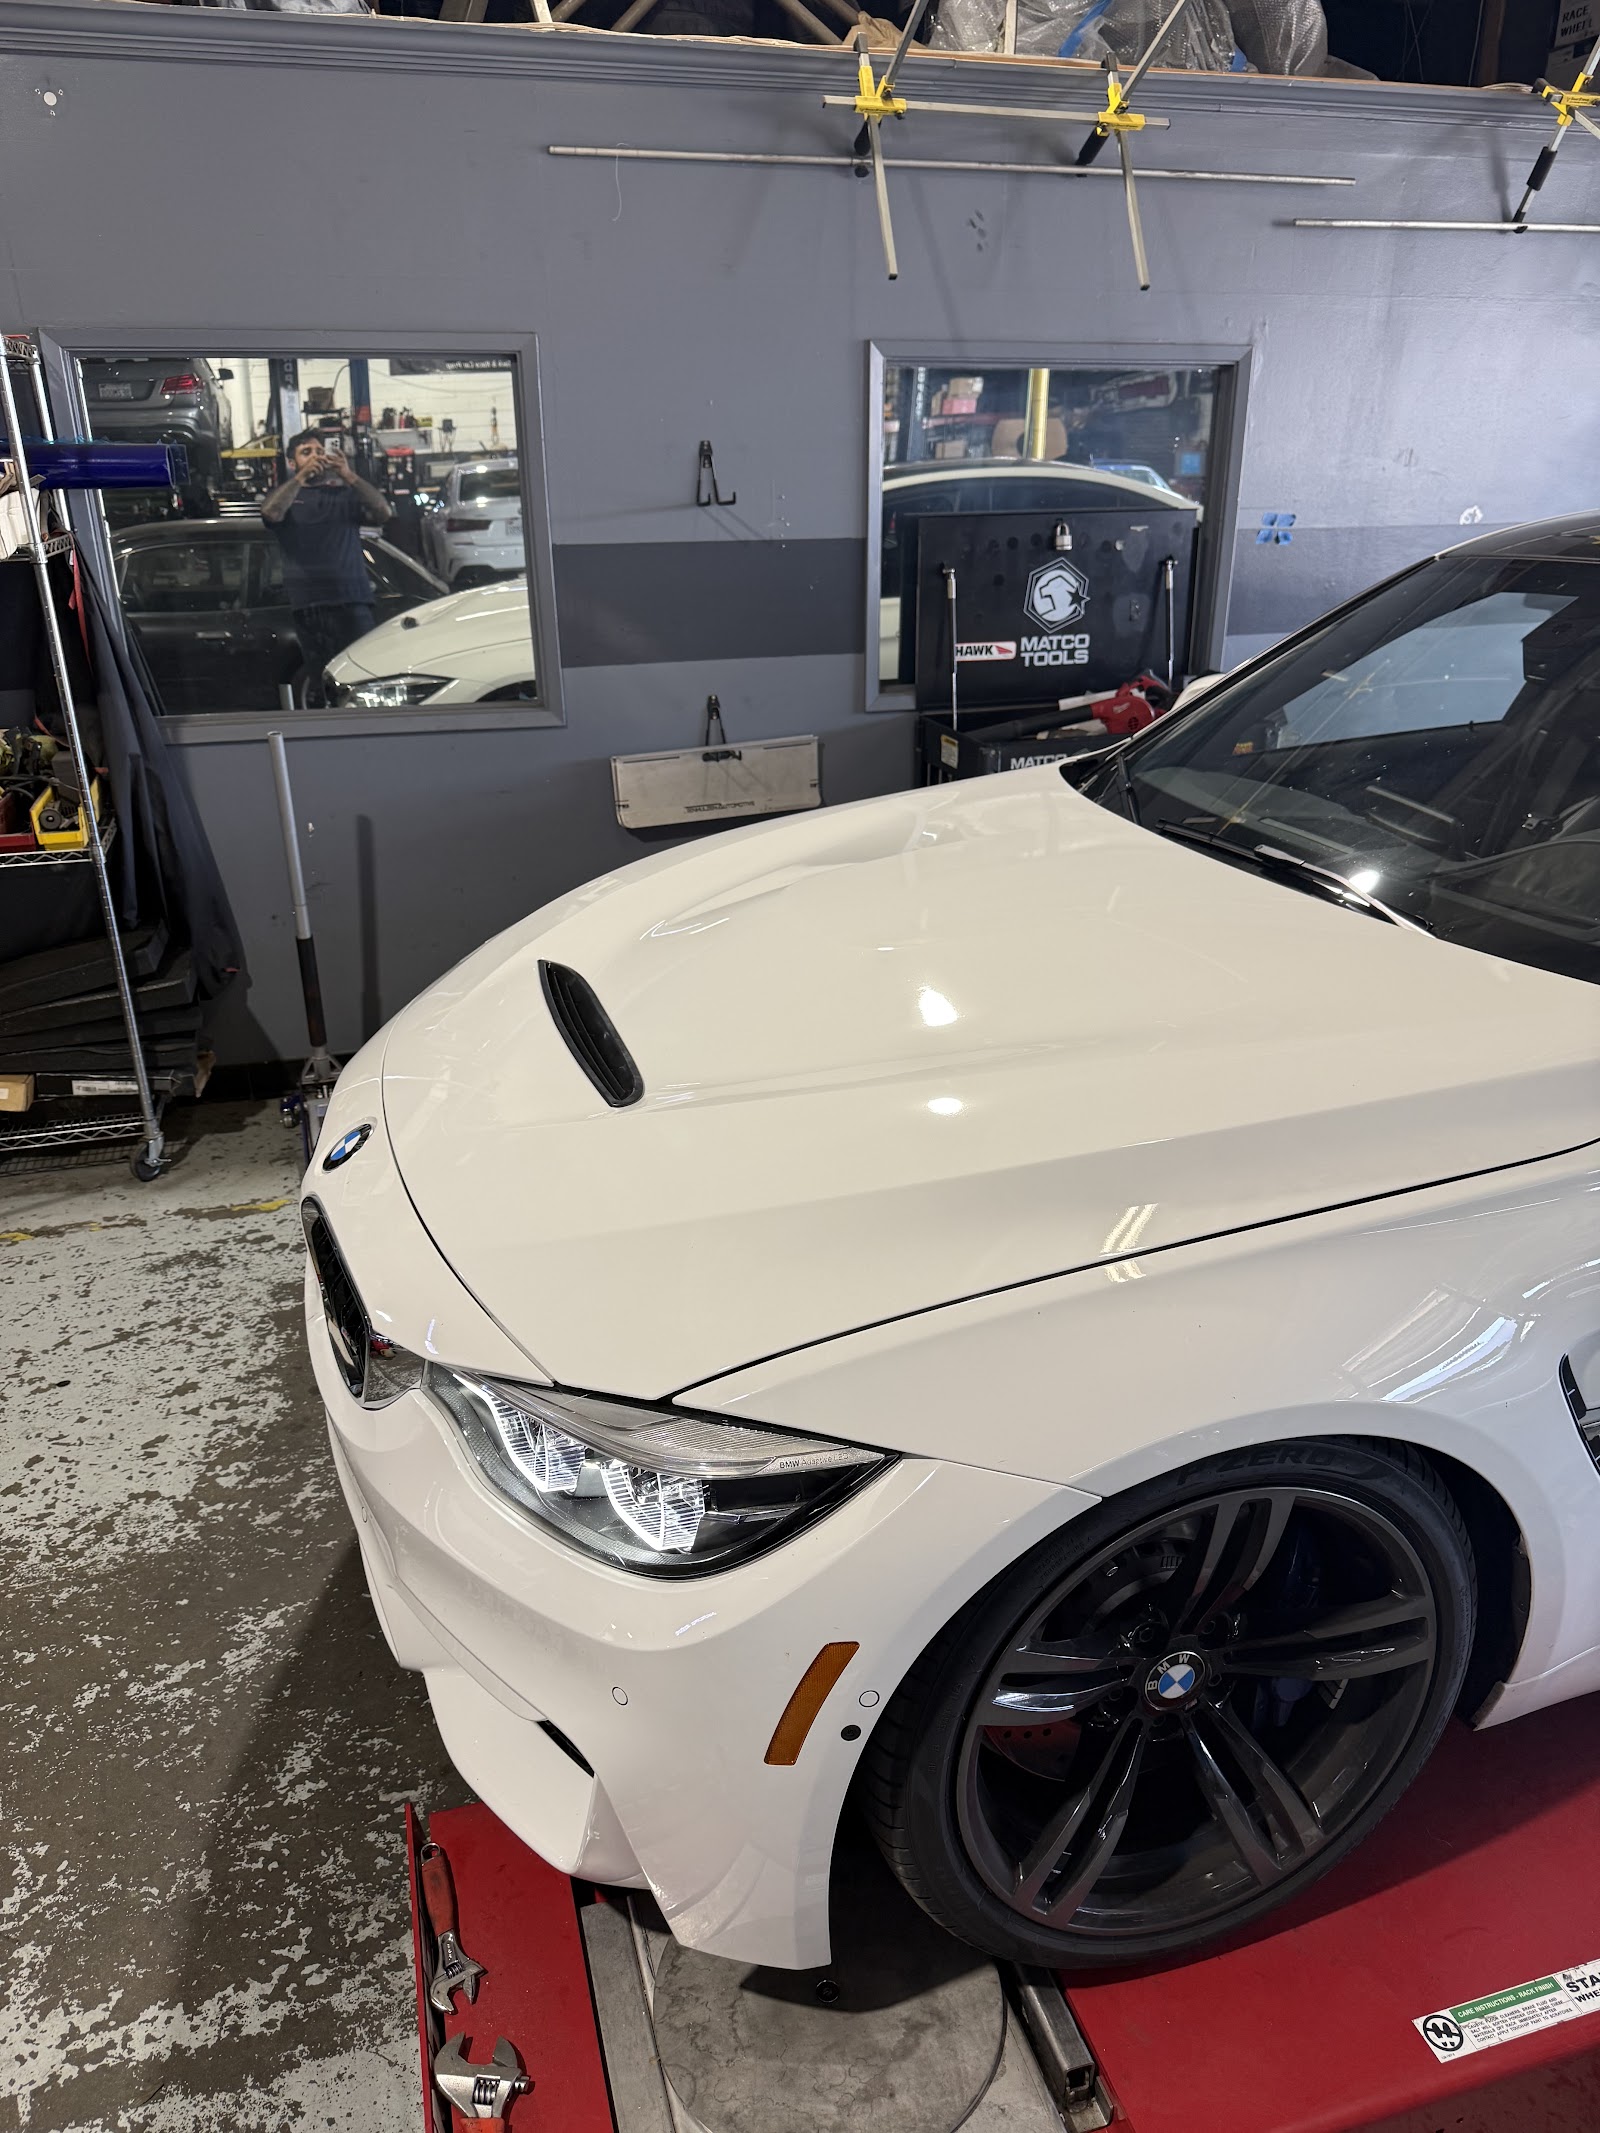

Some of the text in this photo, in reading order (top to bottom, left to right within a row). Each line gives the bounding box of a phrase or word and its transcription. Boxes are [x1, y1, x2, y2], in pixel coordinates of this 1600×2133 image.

[1563, 4, 1589, 22] RACE
[956, 645, 993, 656] HAWK
[1020, 634, 1090, 652] MATCO
[1020, 650, 1089, 667] TOOLS
[780, 1459, 800, 1469] BMW
[1215, 1446, 1339, 1473] ZERO
[1148, 1653, 1190, 1690] BMW
[1566, 1972, 1600, 1993] STA
[1457, 2007, 1474, 2018] CARE
[1474, 1994, 1517, 2013] INSTRUCTIONS
[1518, 1988, 1535, 1999] RACK
[1535, 1982, 1555, 1993] FINISH
[1575, 1987, 1600, 2003] WHE
